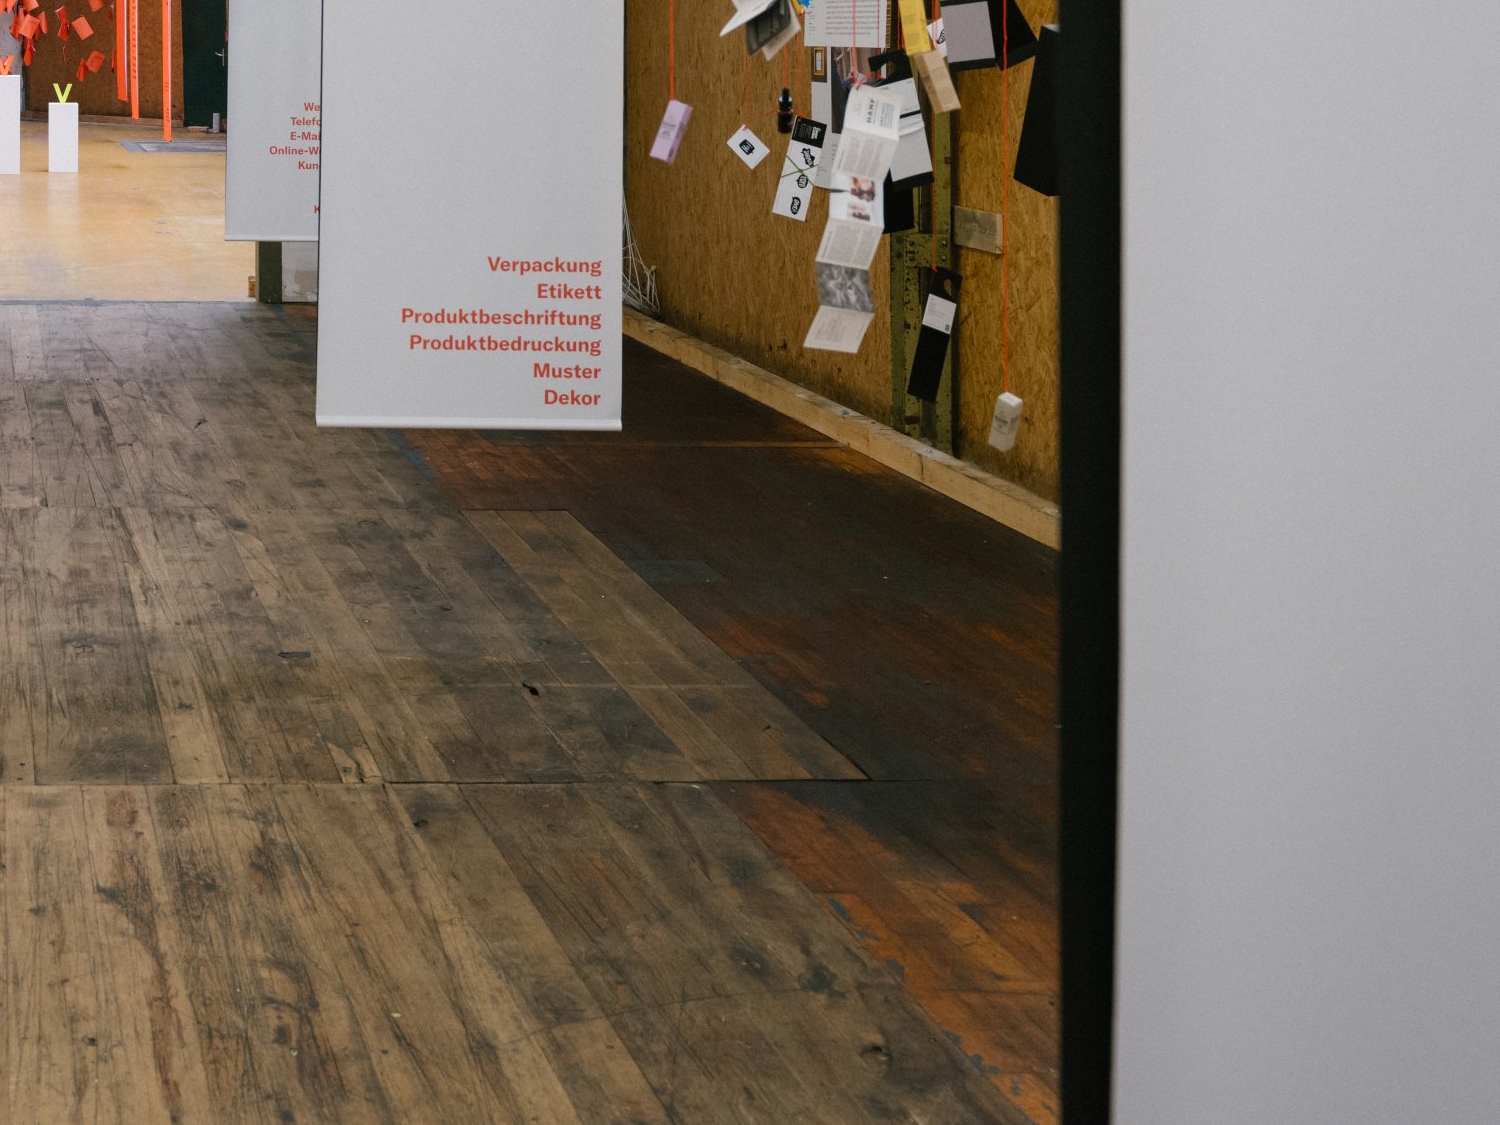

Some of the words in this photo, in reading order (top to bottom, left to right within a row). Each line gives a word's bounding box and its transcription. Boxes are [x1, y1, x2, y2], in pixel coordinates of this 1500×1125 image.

[487, 256, 602, 275] Verpackung
[537, 284, 602, 299] Etikett
[401, 309, 602, 328] Produktbeschriftung
[410, 336, 602, 355] Produktbedruckung
[533, 363, 601, 379] Muster
[544, 390, 601, 405] Dekor
